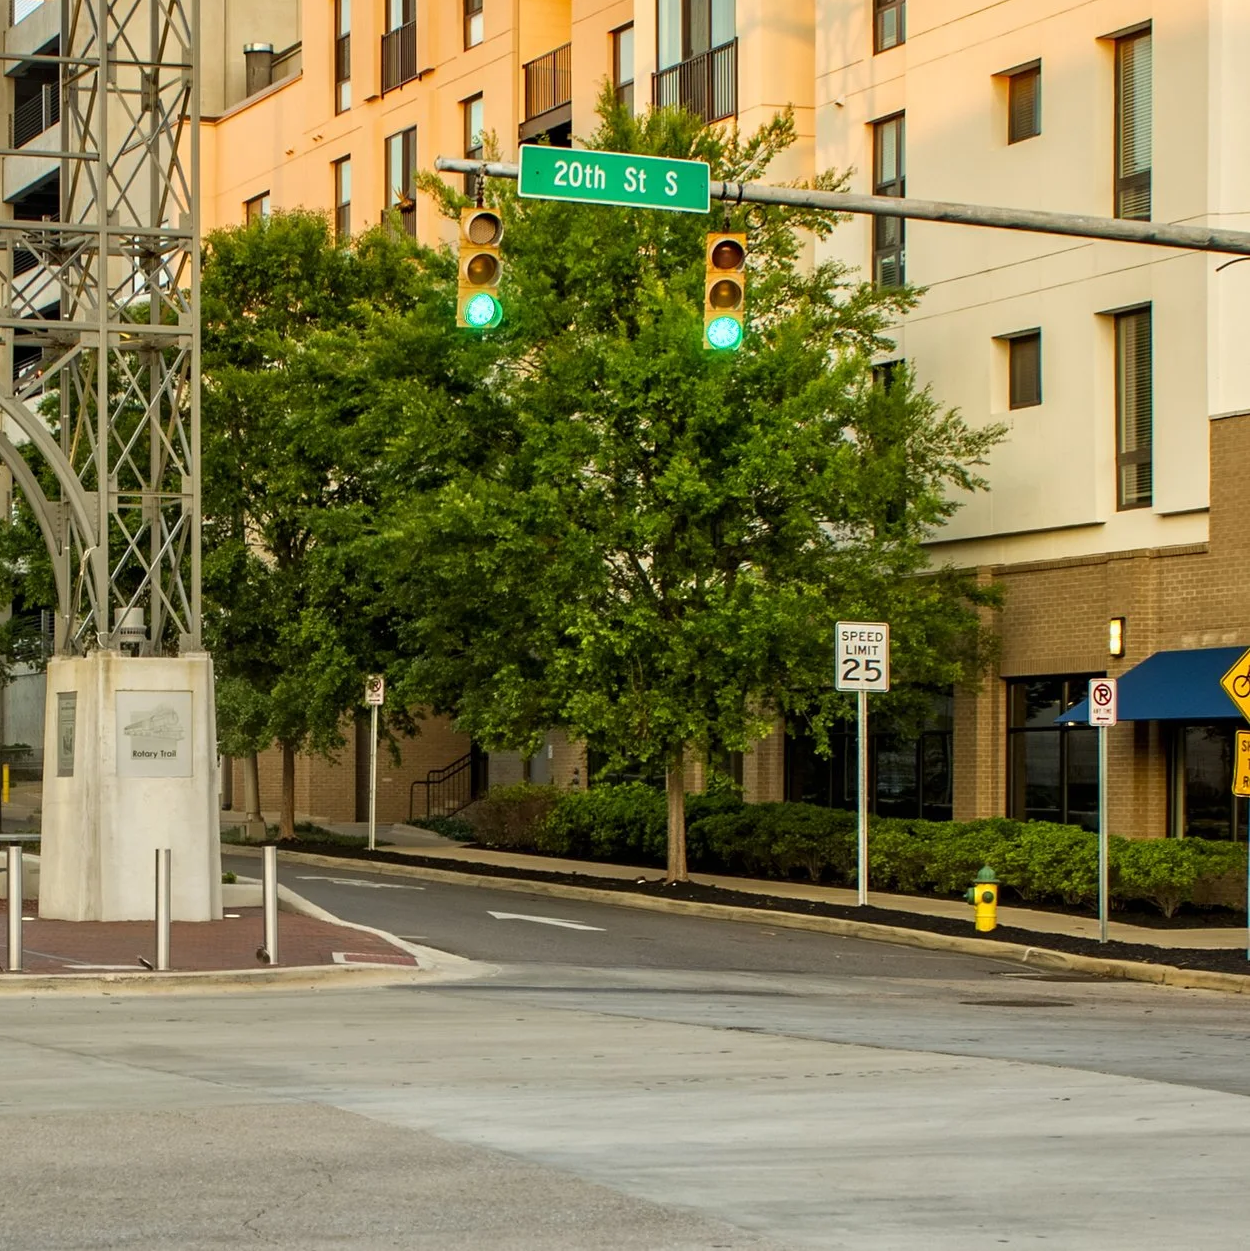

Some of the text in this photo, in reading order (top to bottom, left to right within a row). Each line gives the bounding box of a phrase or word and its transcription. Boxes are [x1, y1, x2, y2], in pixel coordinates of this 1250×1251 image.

[554, 160, 678, 196] 20th St S
[842, 631, 883, 642] SPEED
[846, 645, 879, 655] LIMIT
[842, 658, 882, 682] 25
[132, 750, 177, 759] Rotary Trail
